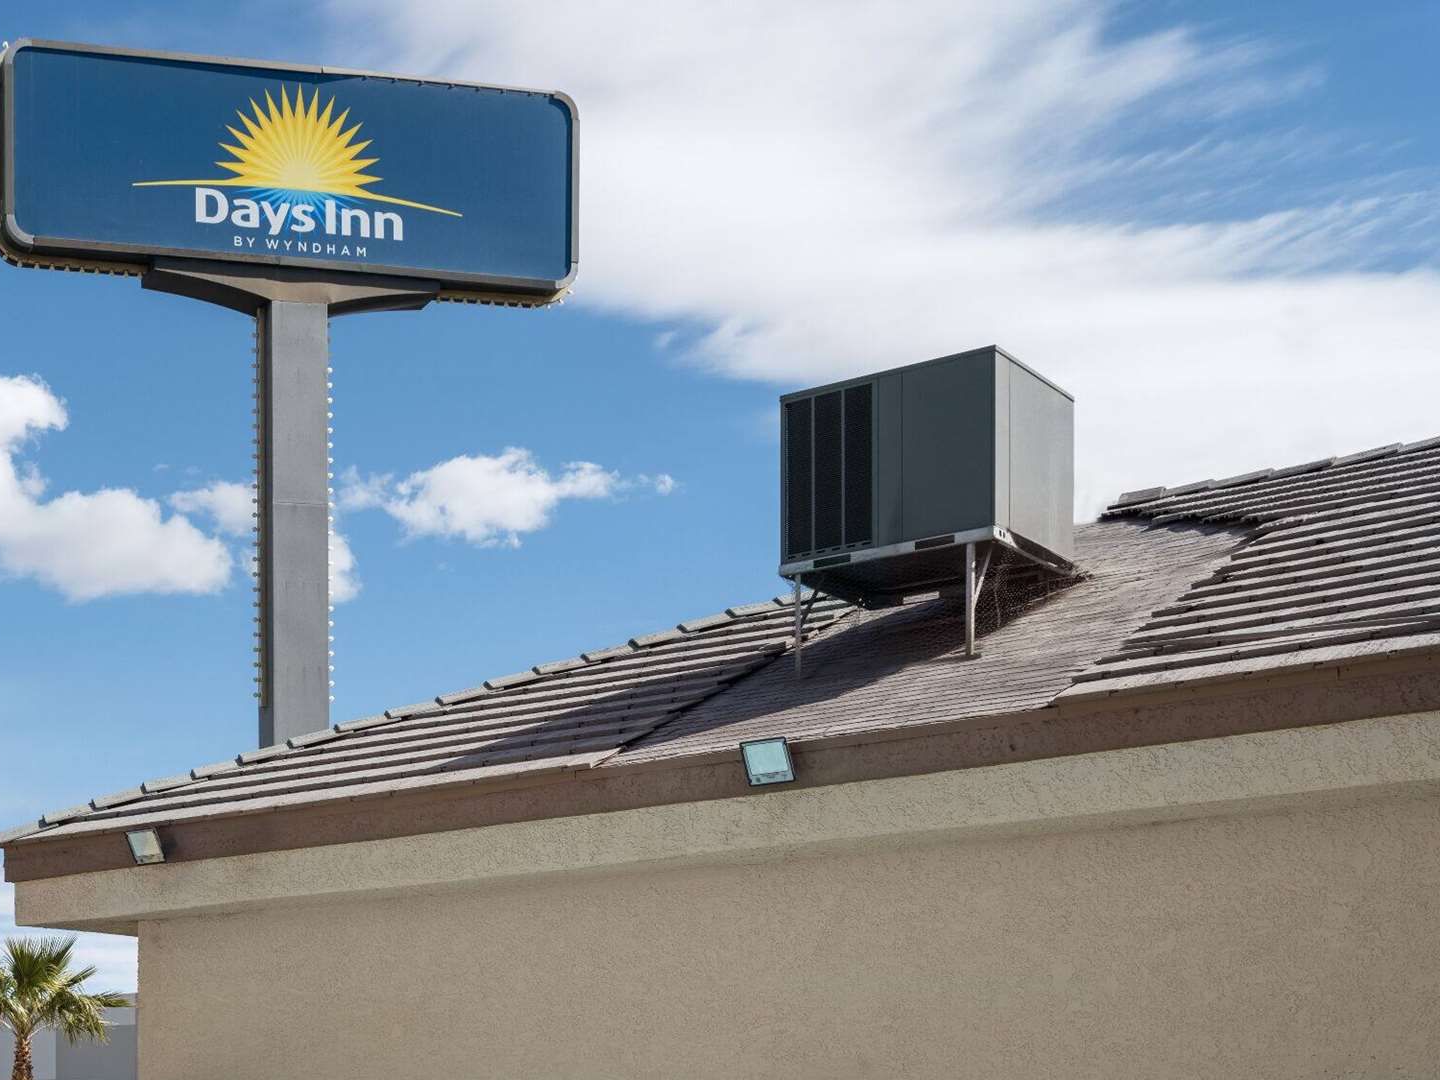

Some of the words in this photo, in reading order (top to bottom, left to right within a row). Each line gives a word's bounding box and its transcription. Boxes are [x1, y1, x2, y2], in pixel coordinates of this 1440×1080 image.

[195, 187, 315, 235] Days
[325, 199, 404, 241] Inn
[233, 236, 255, 247] BY
[266, 239, 367, 257] WYNDHAM
